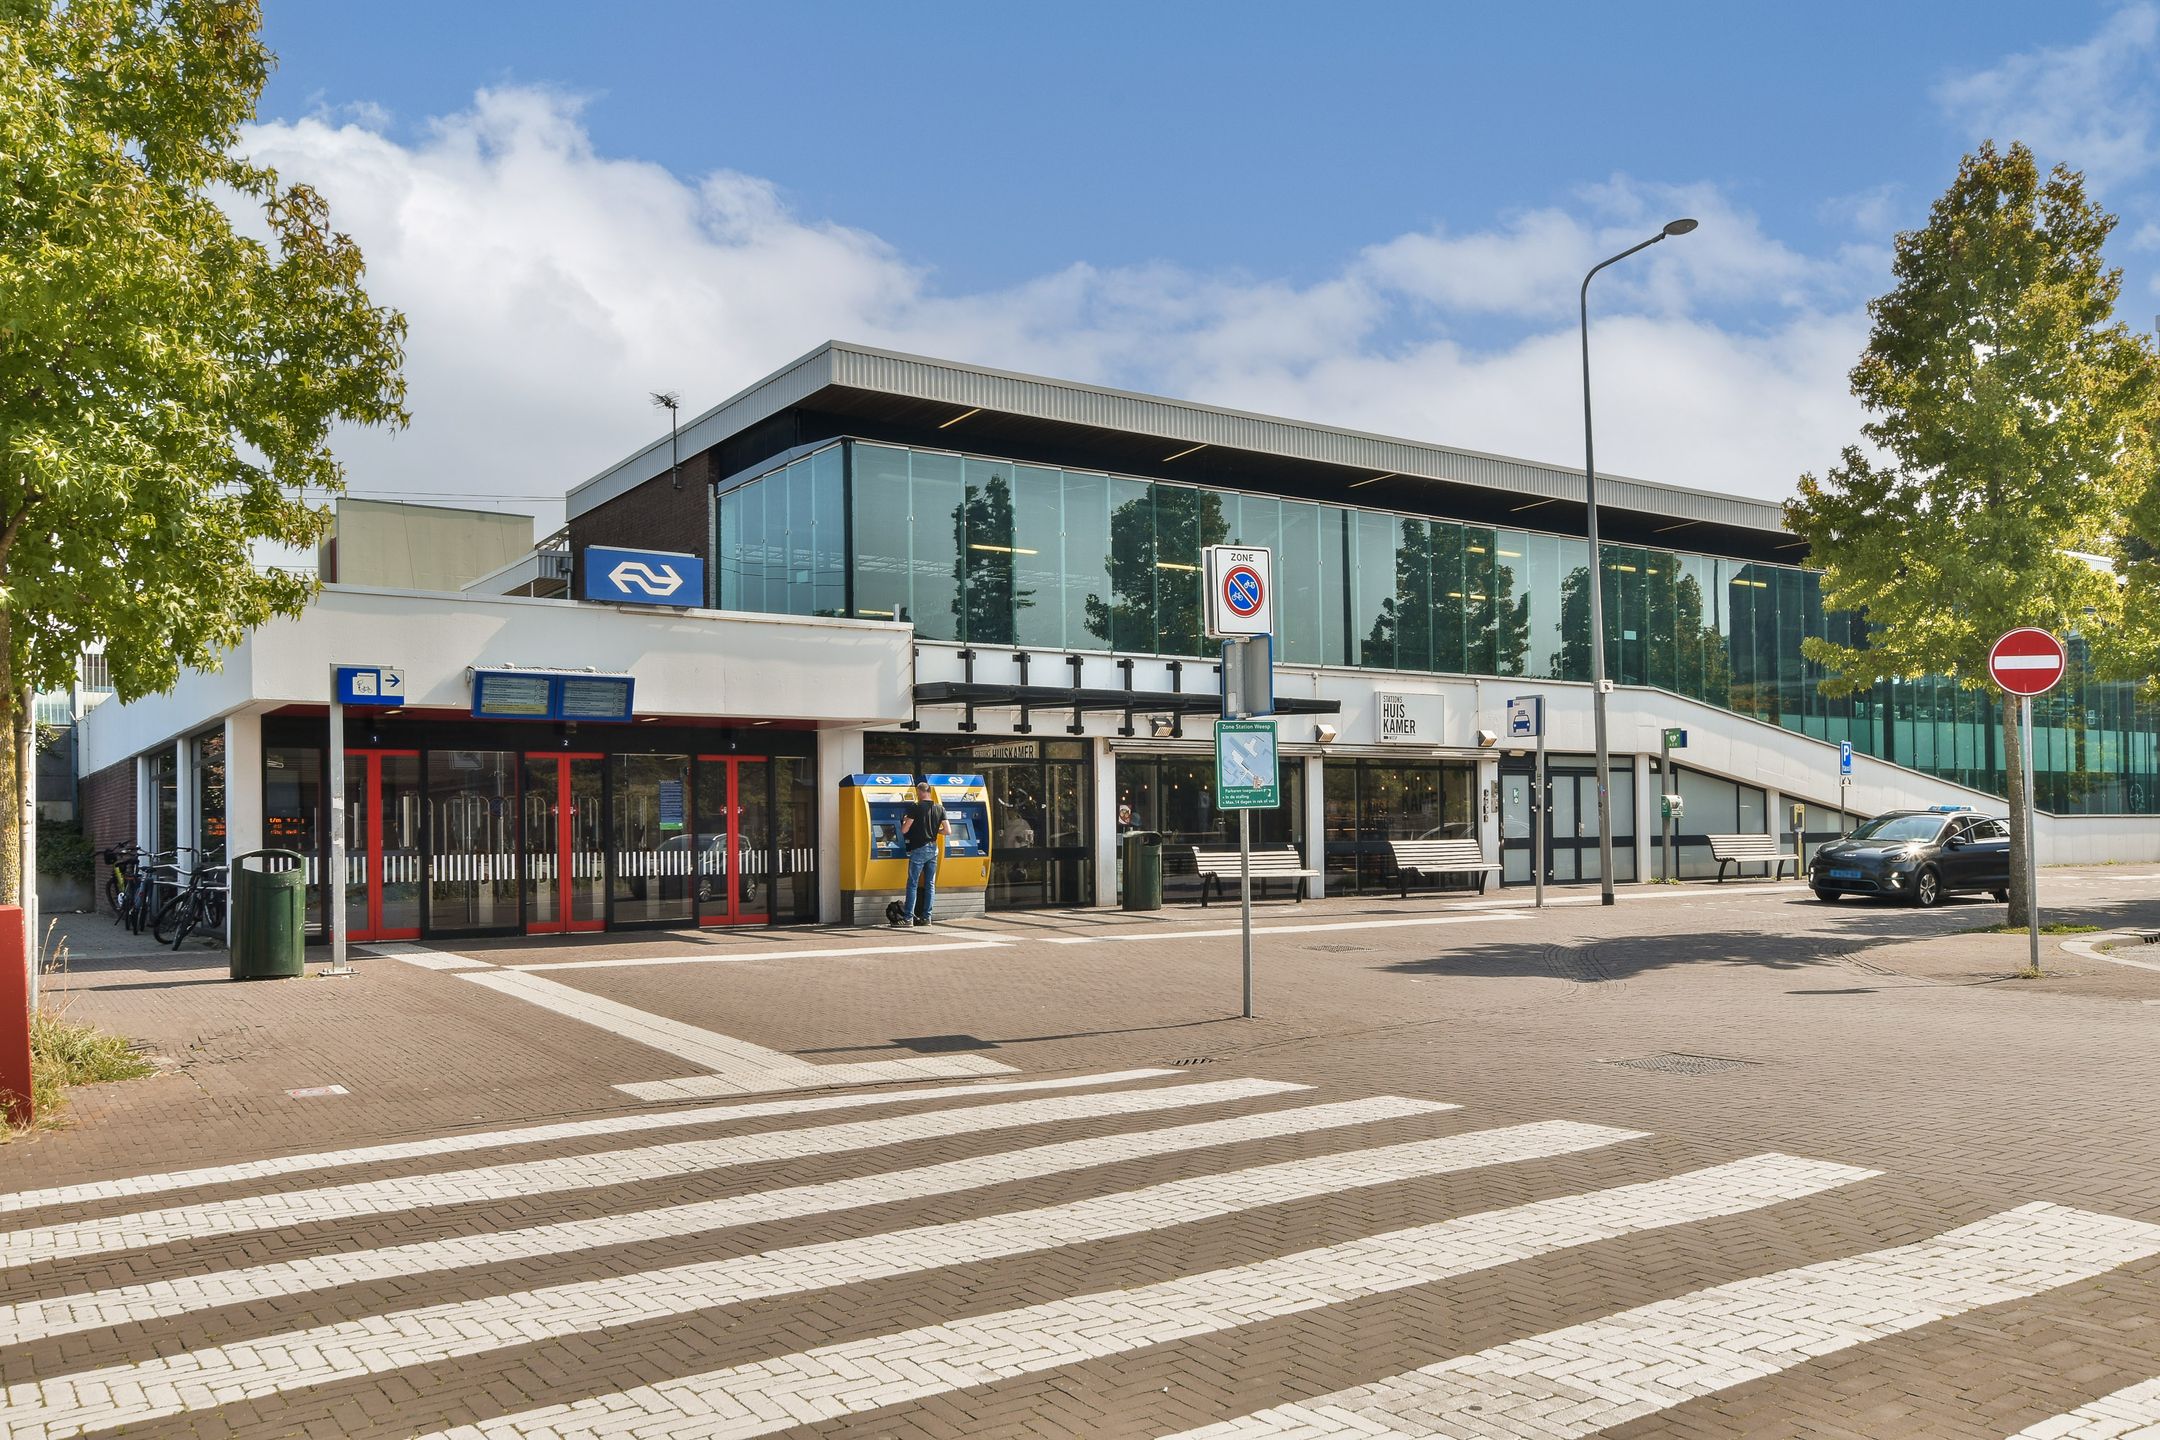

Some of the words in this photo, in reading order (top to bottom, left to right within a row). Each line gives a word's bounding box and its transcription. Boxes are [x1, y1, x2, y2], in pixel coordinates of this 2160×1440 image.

[1231, 553, 1254, 562] ZONE
[1383, 695, 1403, 703] STATIONS
[1383, 703, 1405, 718] HUIS
[1383, 719, 1416, 734] KAMER
[1844, 744, 1850, 762] P
